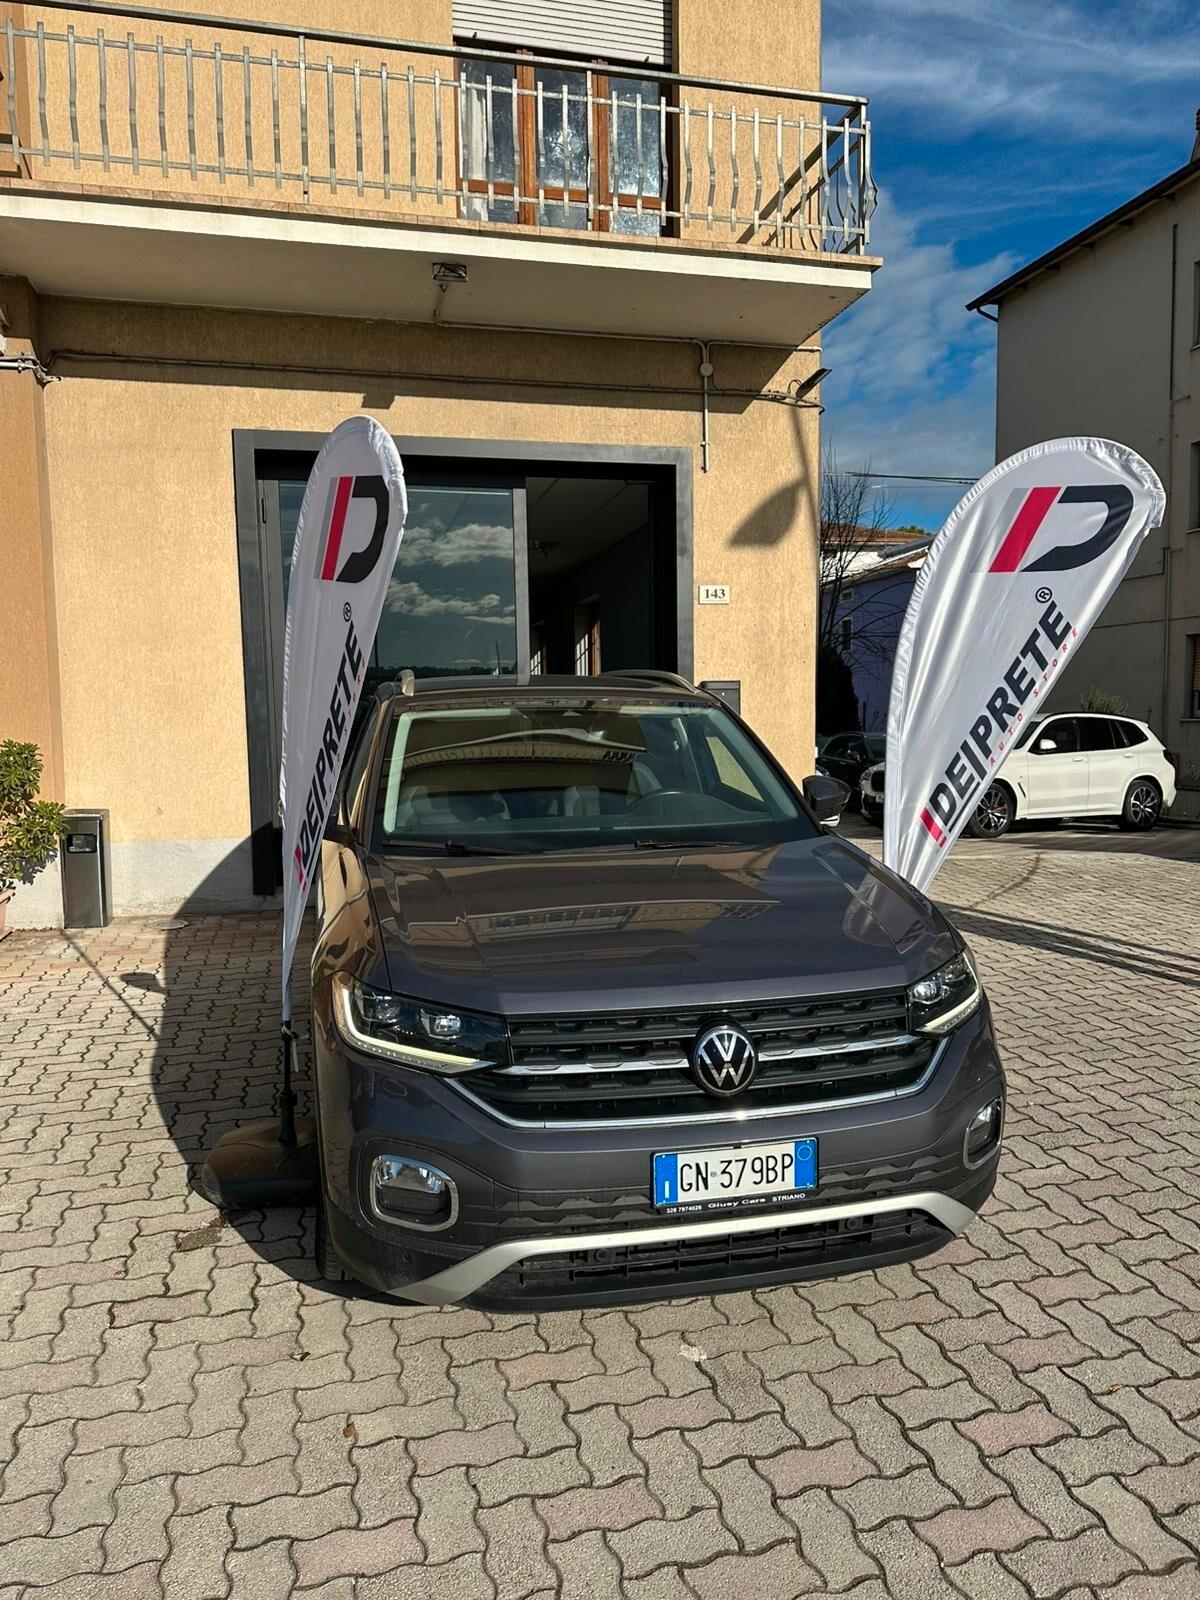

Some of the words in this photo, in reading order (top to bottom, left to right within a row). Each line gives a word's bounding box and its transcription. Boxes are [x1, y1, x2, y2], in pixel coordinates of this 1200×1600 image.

[704, 588, 726, 599] 143
[989, 713, 1024, 766] AUTO
[1033, 627, 1078, 698] STORE
[772, 1192, 806, 1202] STRIANO
